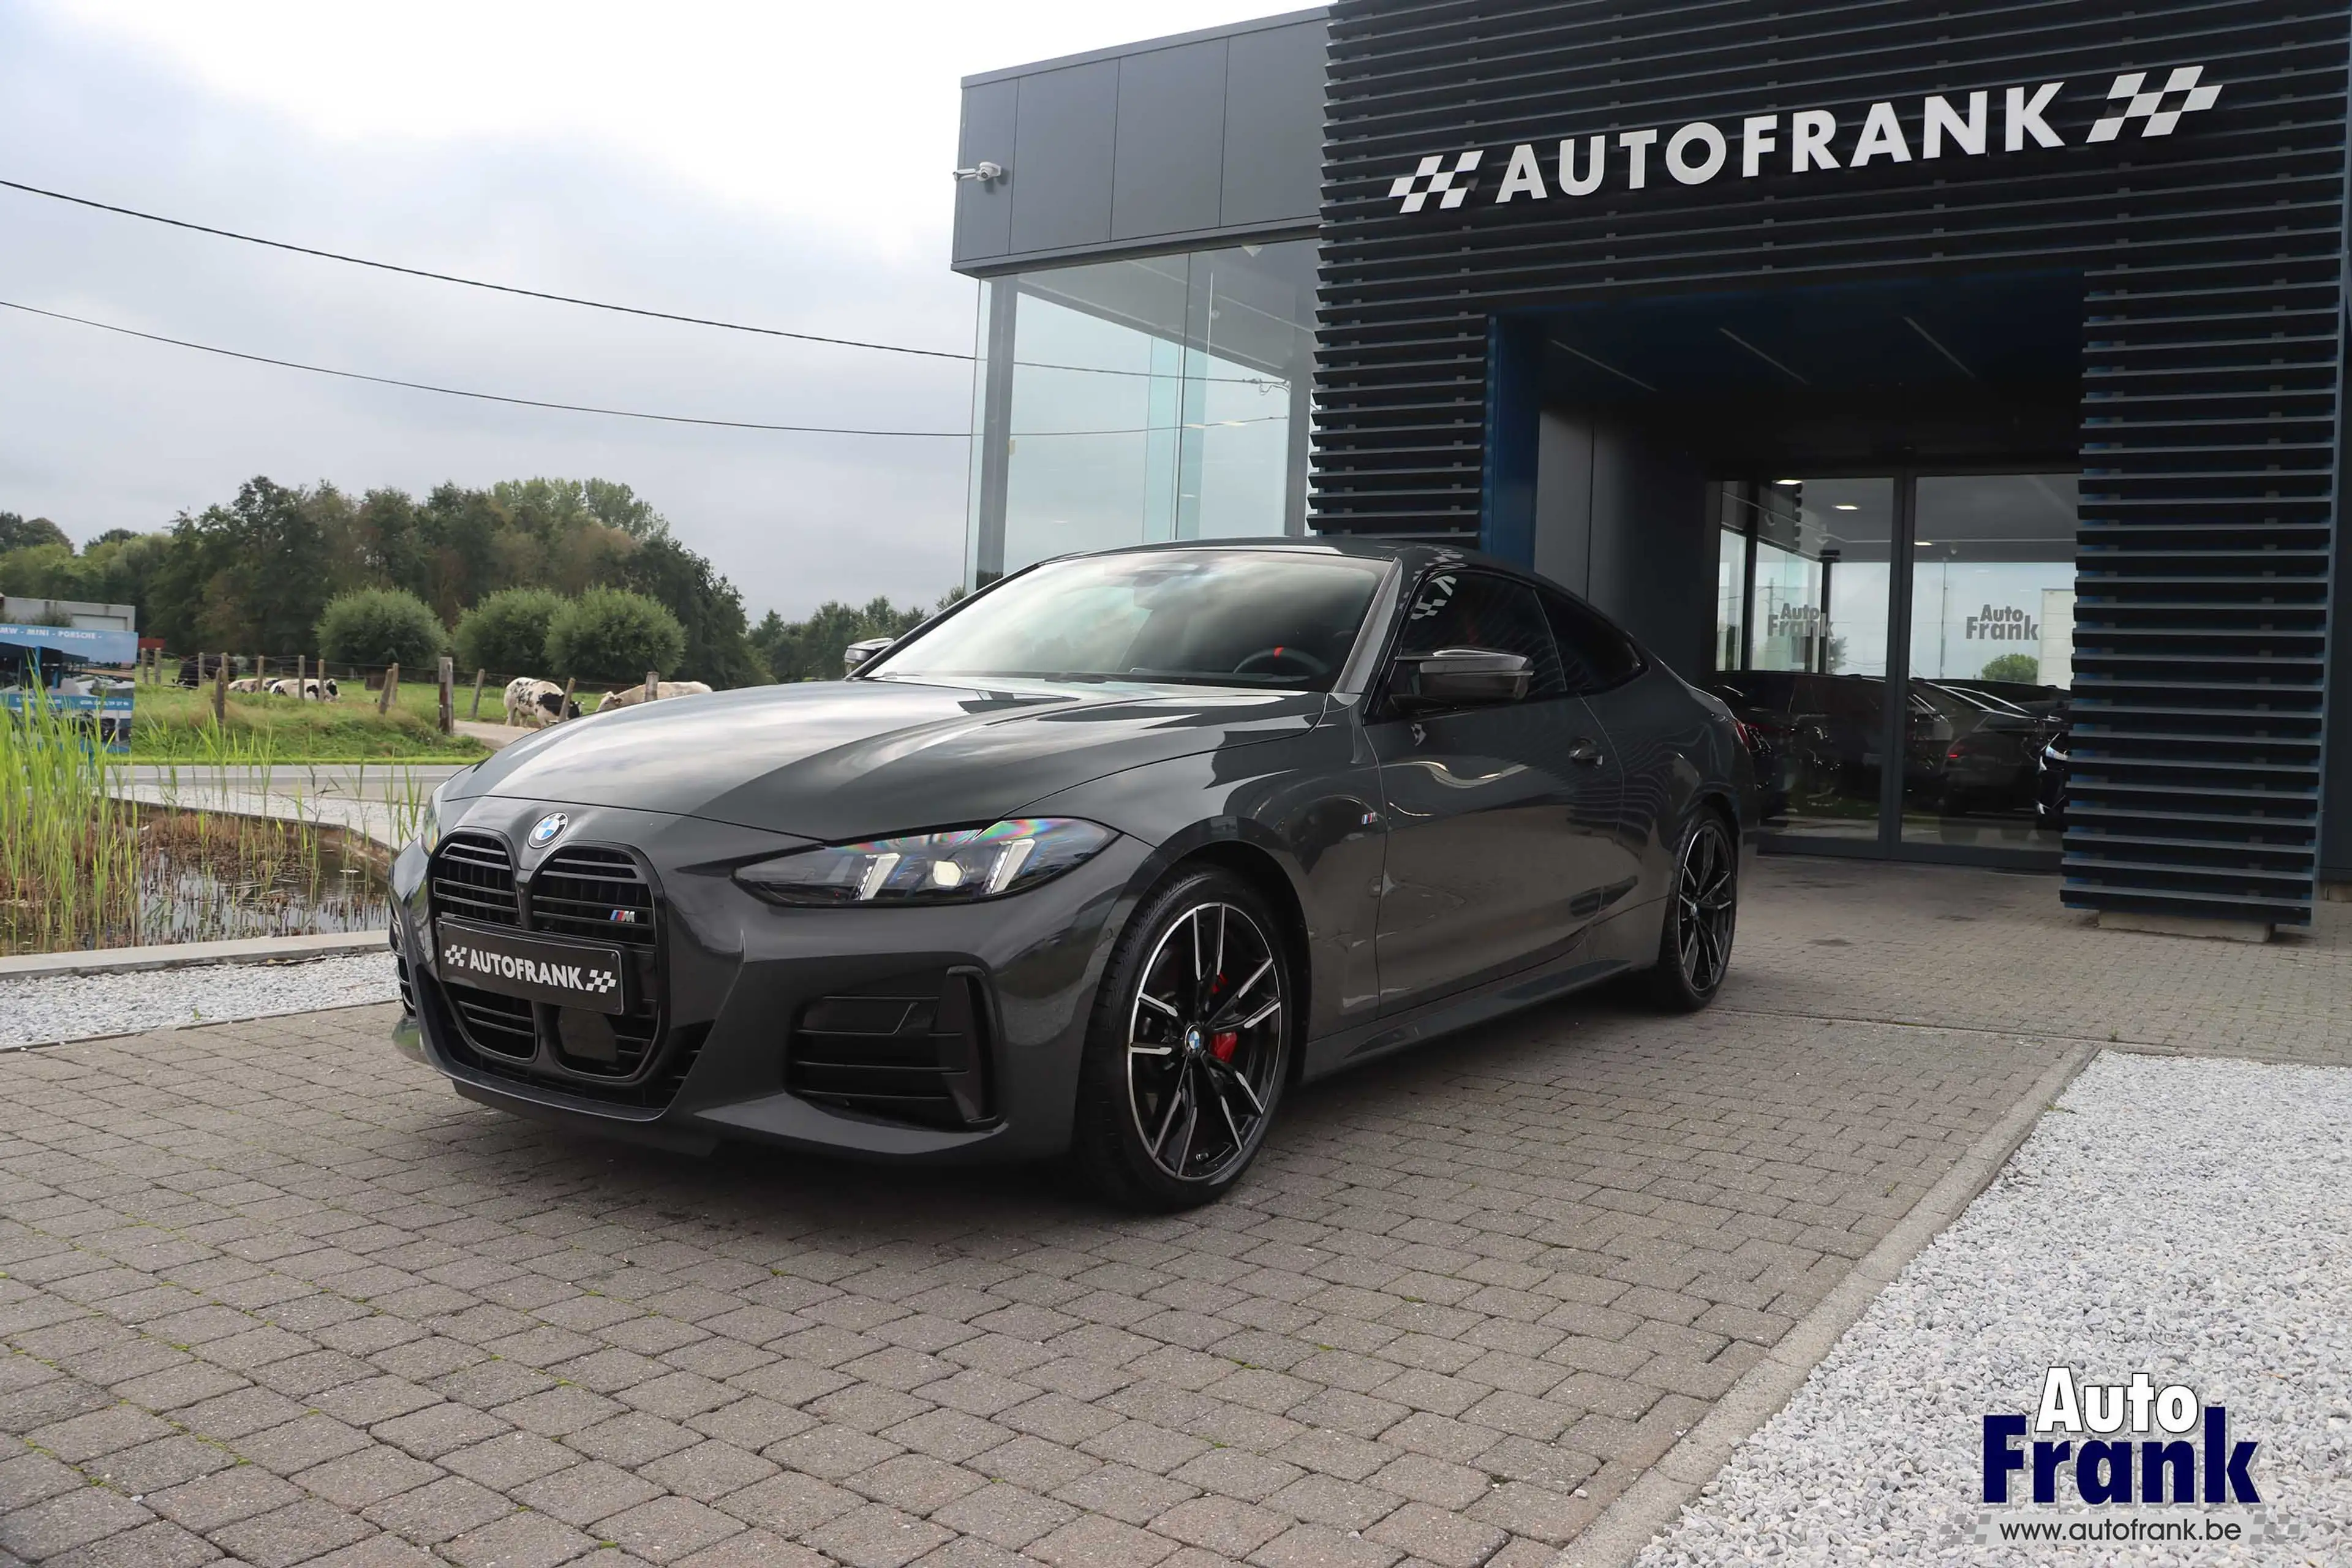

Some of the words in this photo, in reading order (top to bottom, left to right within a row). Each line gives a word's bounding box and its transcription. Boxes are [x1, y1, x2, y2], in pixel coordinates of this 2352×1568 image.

[1495, 81, 2065, 203] AUTOFRANK
[1780, 603, 1820, 620] Auto
[1980, 604, 2024, 622] Auto
[1768, 612, 1834, 637] Frank
[1966, 615, 2039, 640] Frank
[469, 949, 584, 990] AUTOFRANK
